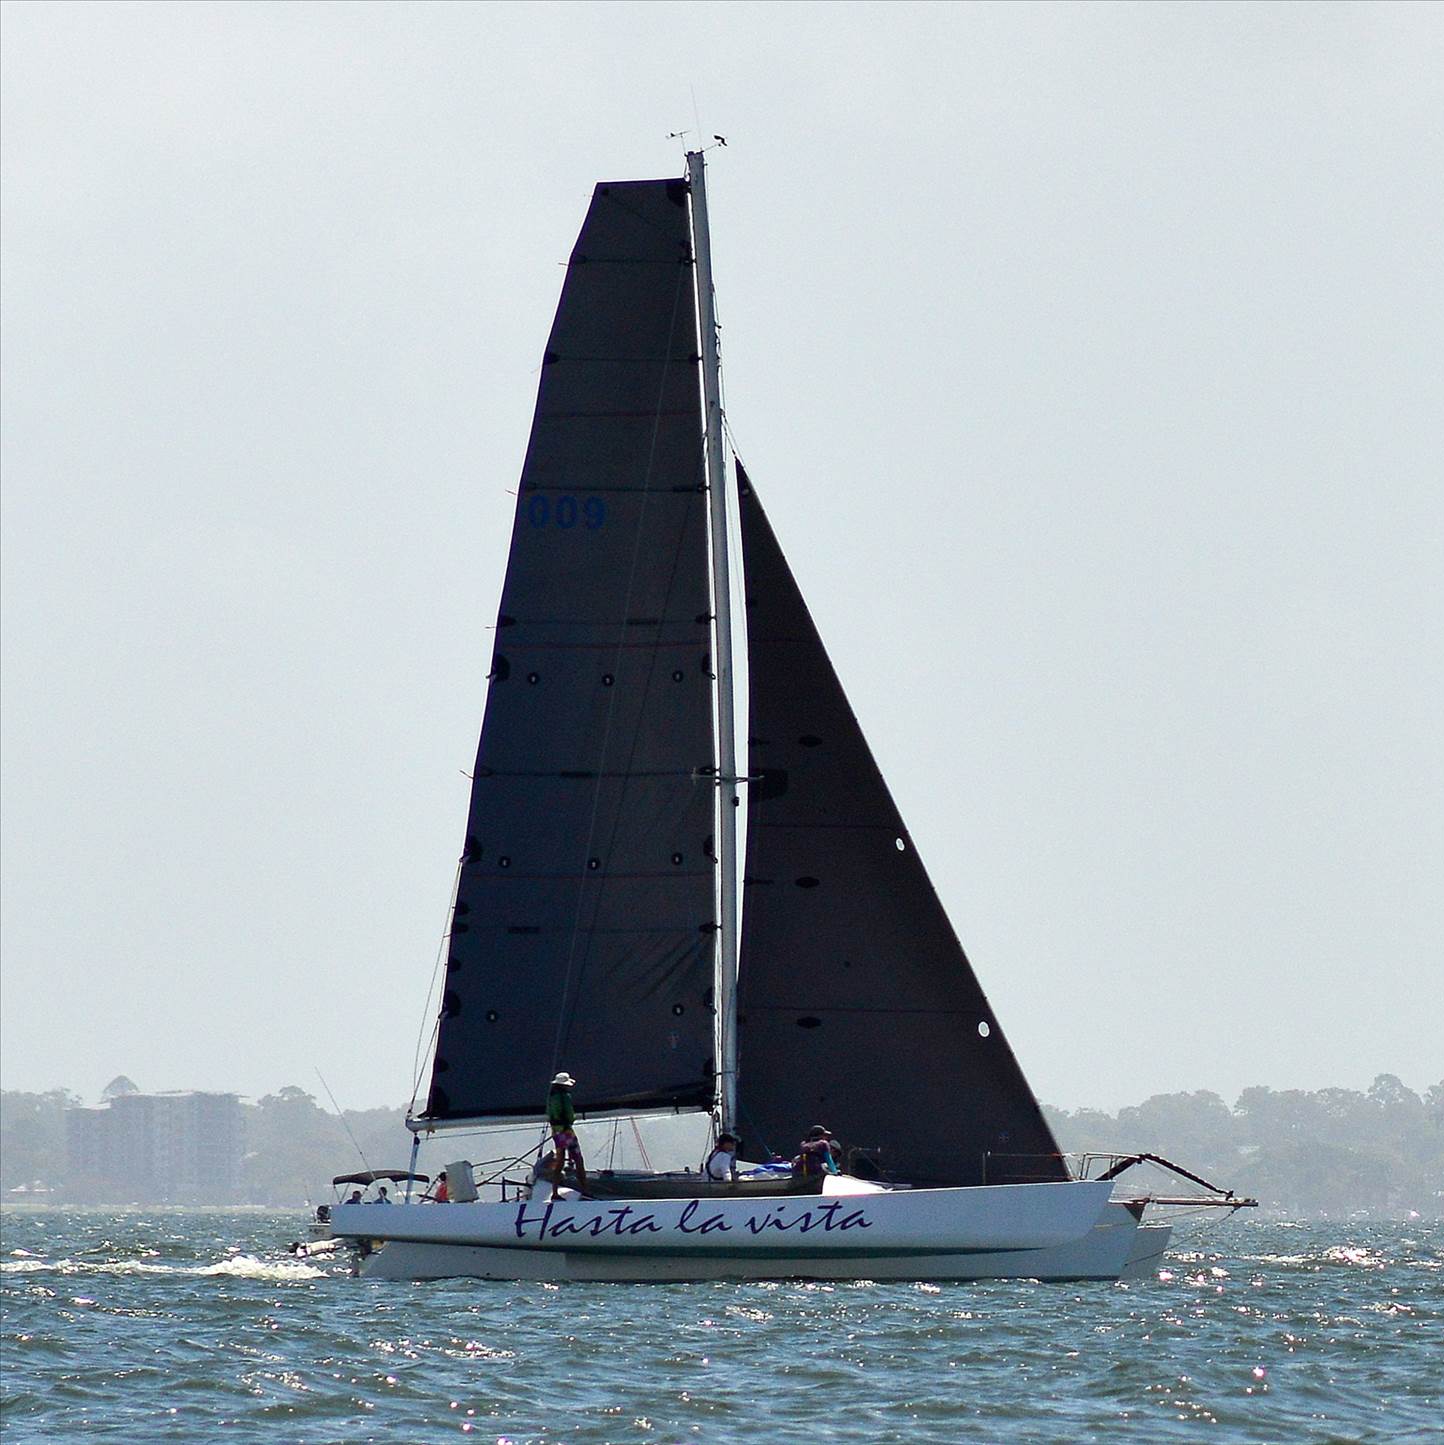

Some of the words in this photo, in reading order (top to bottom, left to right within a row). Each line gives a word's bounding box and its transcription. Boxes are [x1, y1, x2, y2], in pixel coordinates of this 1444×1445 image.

[528, 494, 607, 529] 009
[514, 1202, 662, 1241] Hasta
[674, 1199, 733, 1233] la
[745, 1200, 873, 1232] vista
